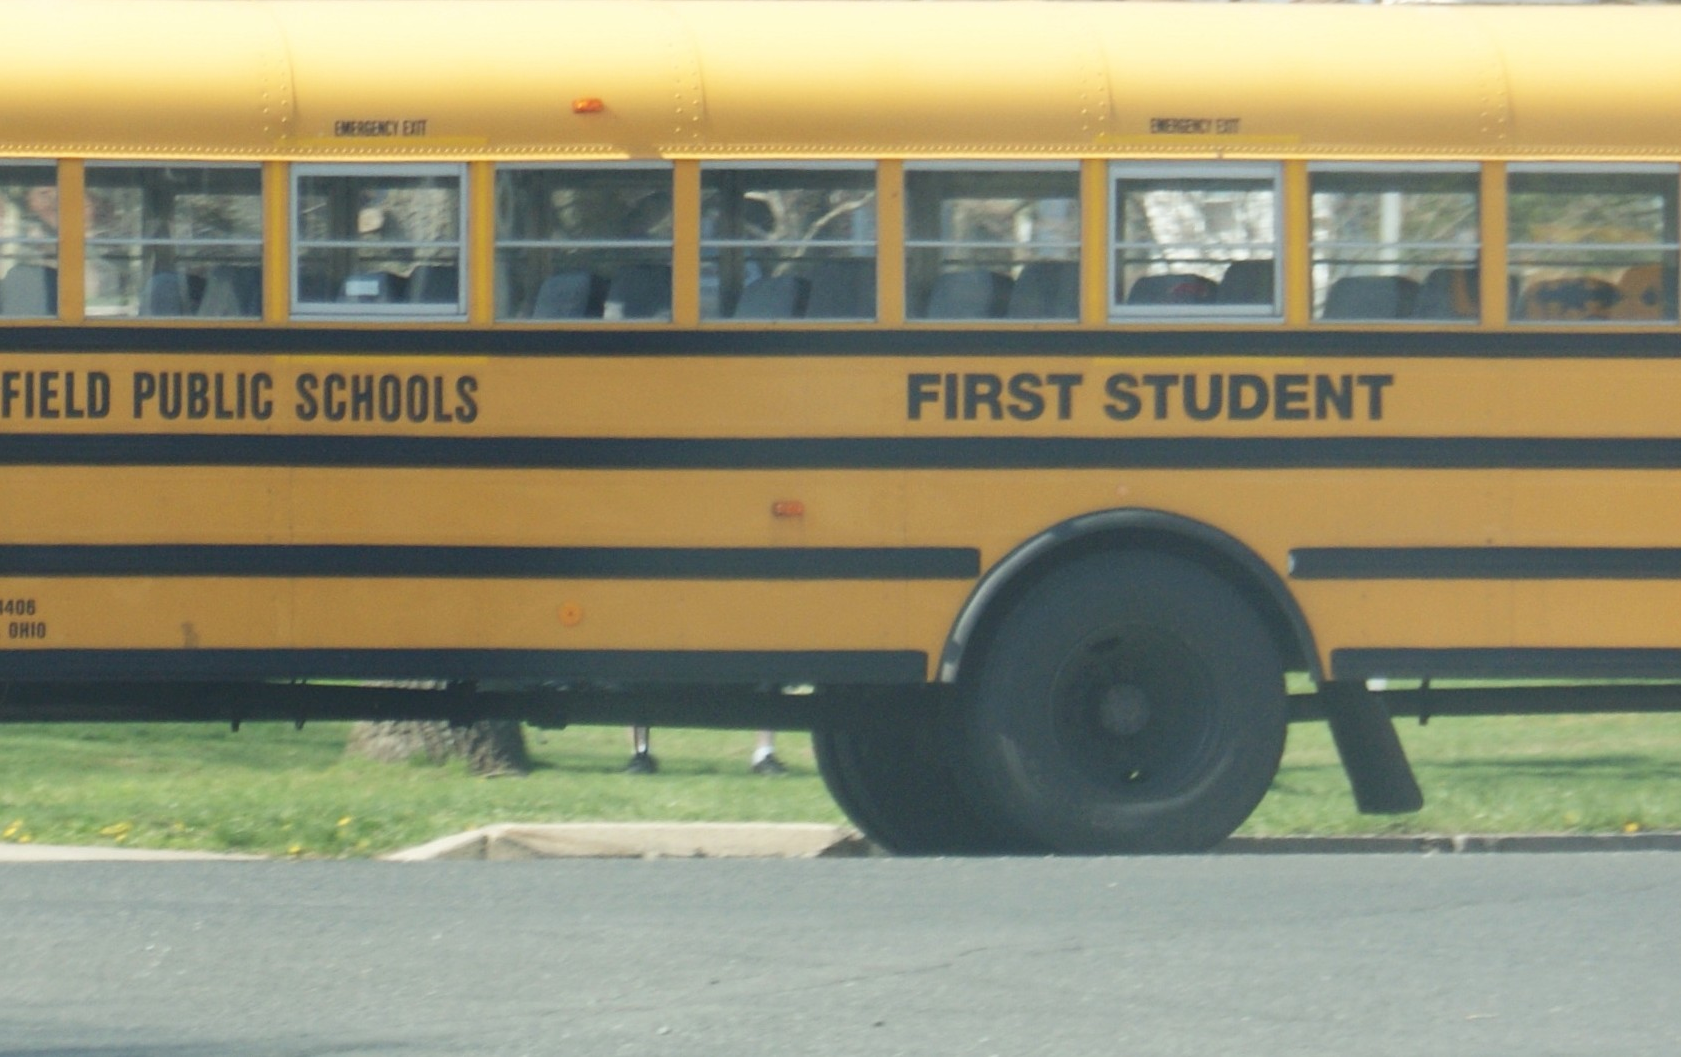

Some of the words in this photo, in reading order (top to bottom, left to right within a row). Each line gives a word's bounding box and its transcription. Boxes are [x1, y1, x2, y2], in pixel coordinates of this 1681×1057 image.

[334, 120, 398, 137] EMERGENCY
[402, 119, 427, 137] EXIT
[1150, 117, 1213, 135] EMERGENCY
[1215, 117, 1240, 135] EXIT
[132, 371, 274, 421] PUBLIC
[295, 373, 479, 424] SCHOOLS
[906, 372, 1083, 421] FIRST
[1102, 373, 1394, 421] STUDENT
[8, 621, 47, 639] OHIO
